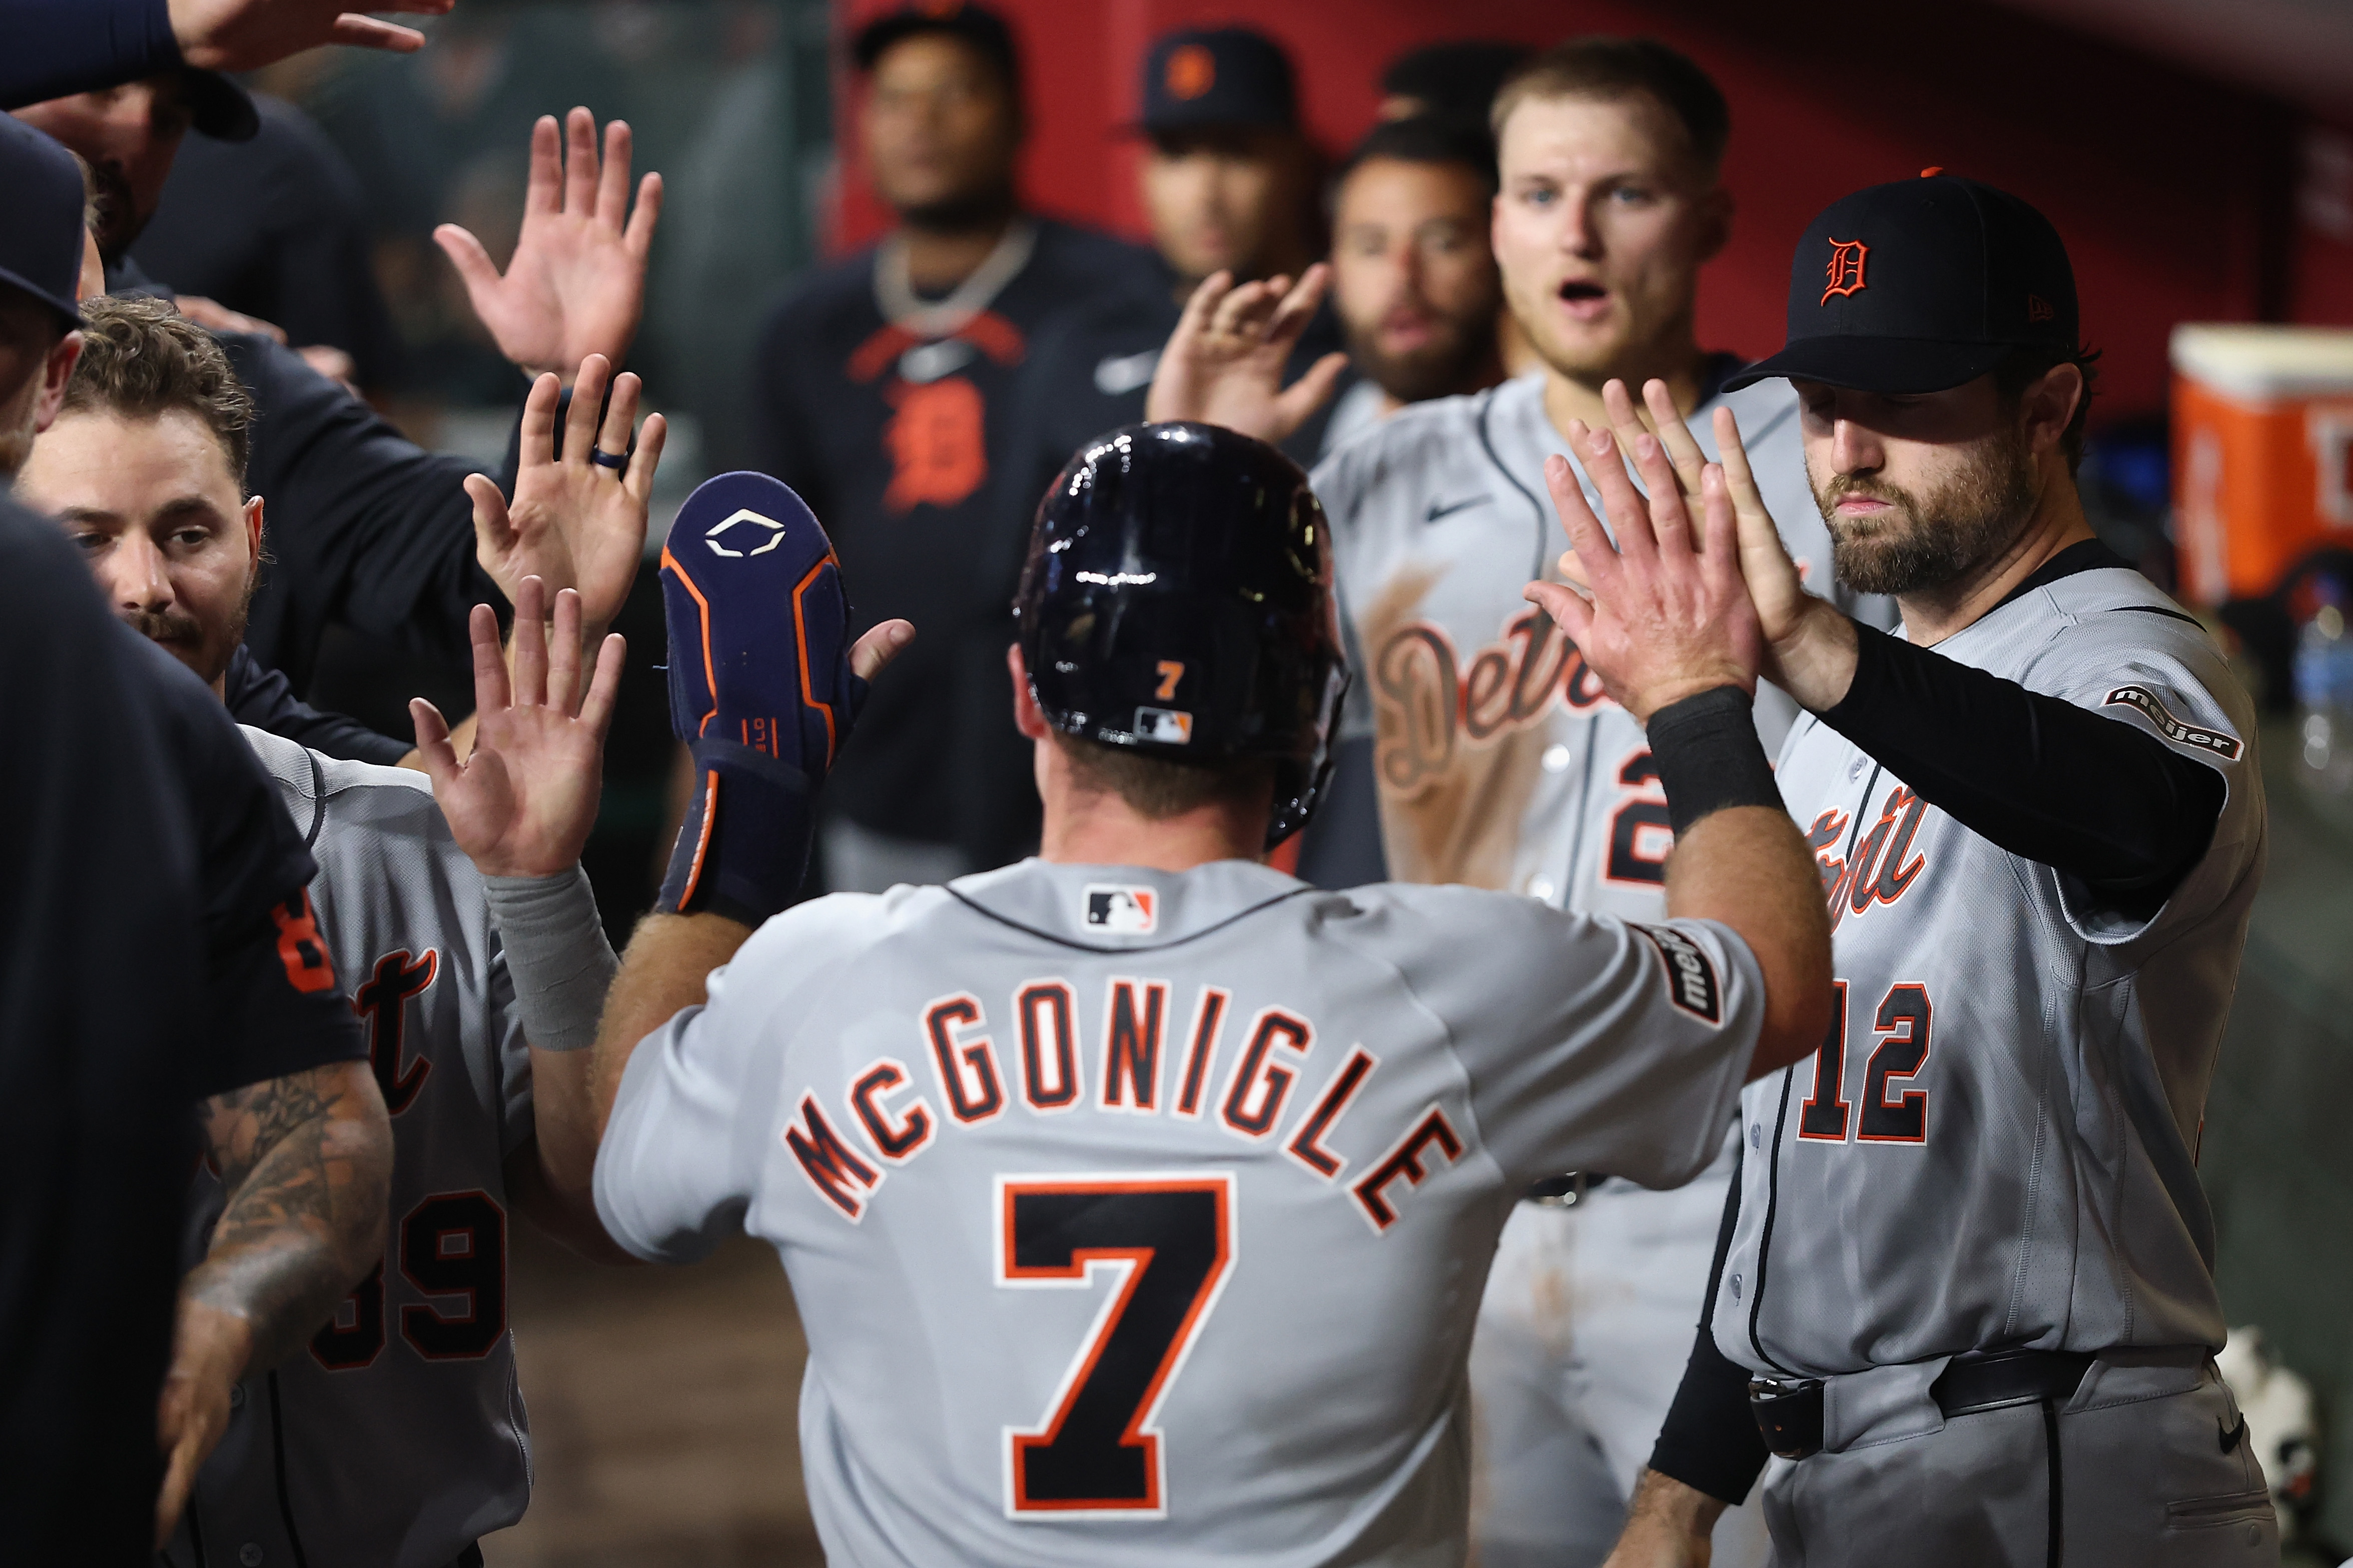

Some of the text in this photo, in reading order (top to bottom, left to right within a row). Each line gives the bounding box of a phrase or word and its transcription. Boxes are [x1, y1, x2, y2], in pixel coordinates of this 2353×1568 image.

[1155, 659, 1185, 700] 7
[2114, 689, 2230, 749] meijer
[1796, 978, 1934, 1146] 12
[993, 1170, 1238, 1520] 7
